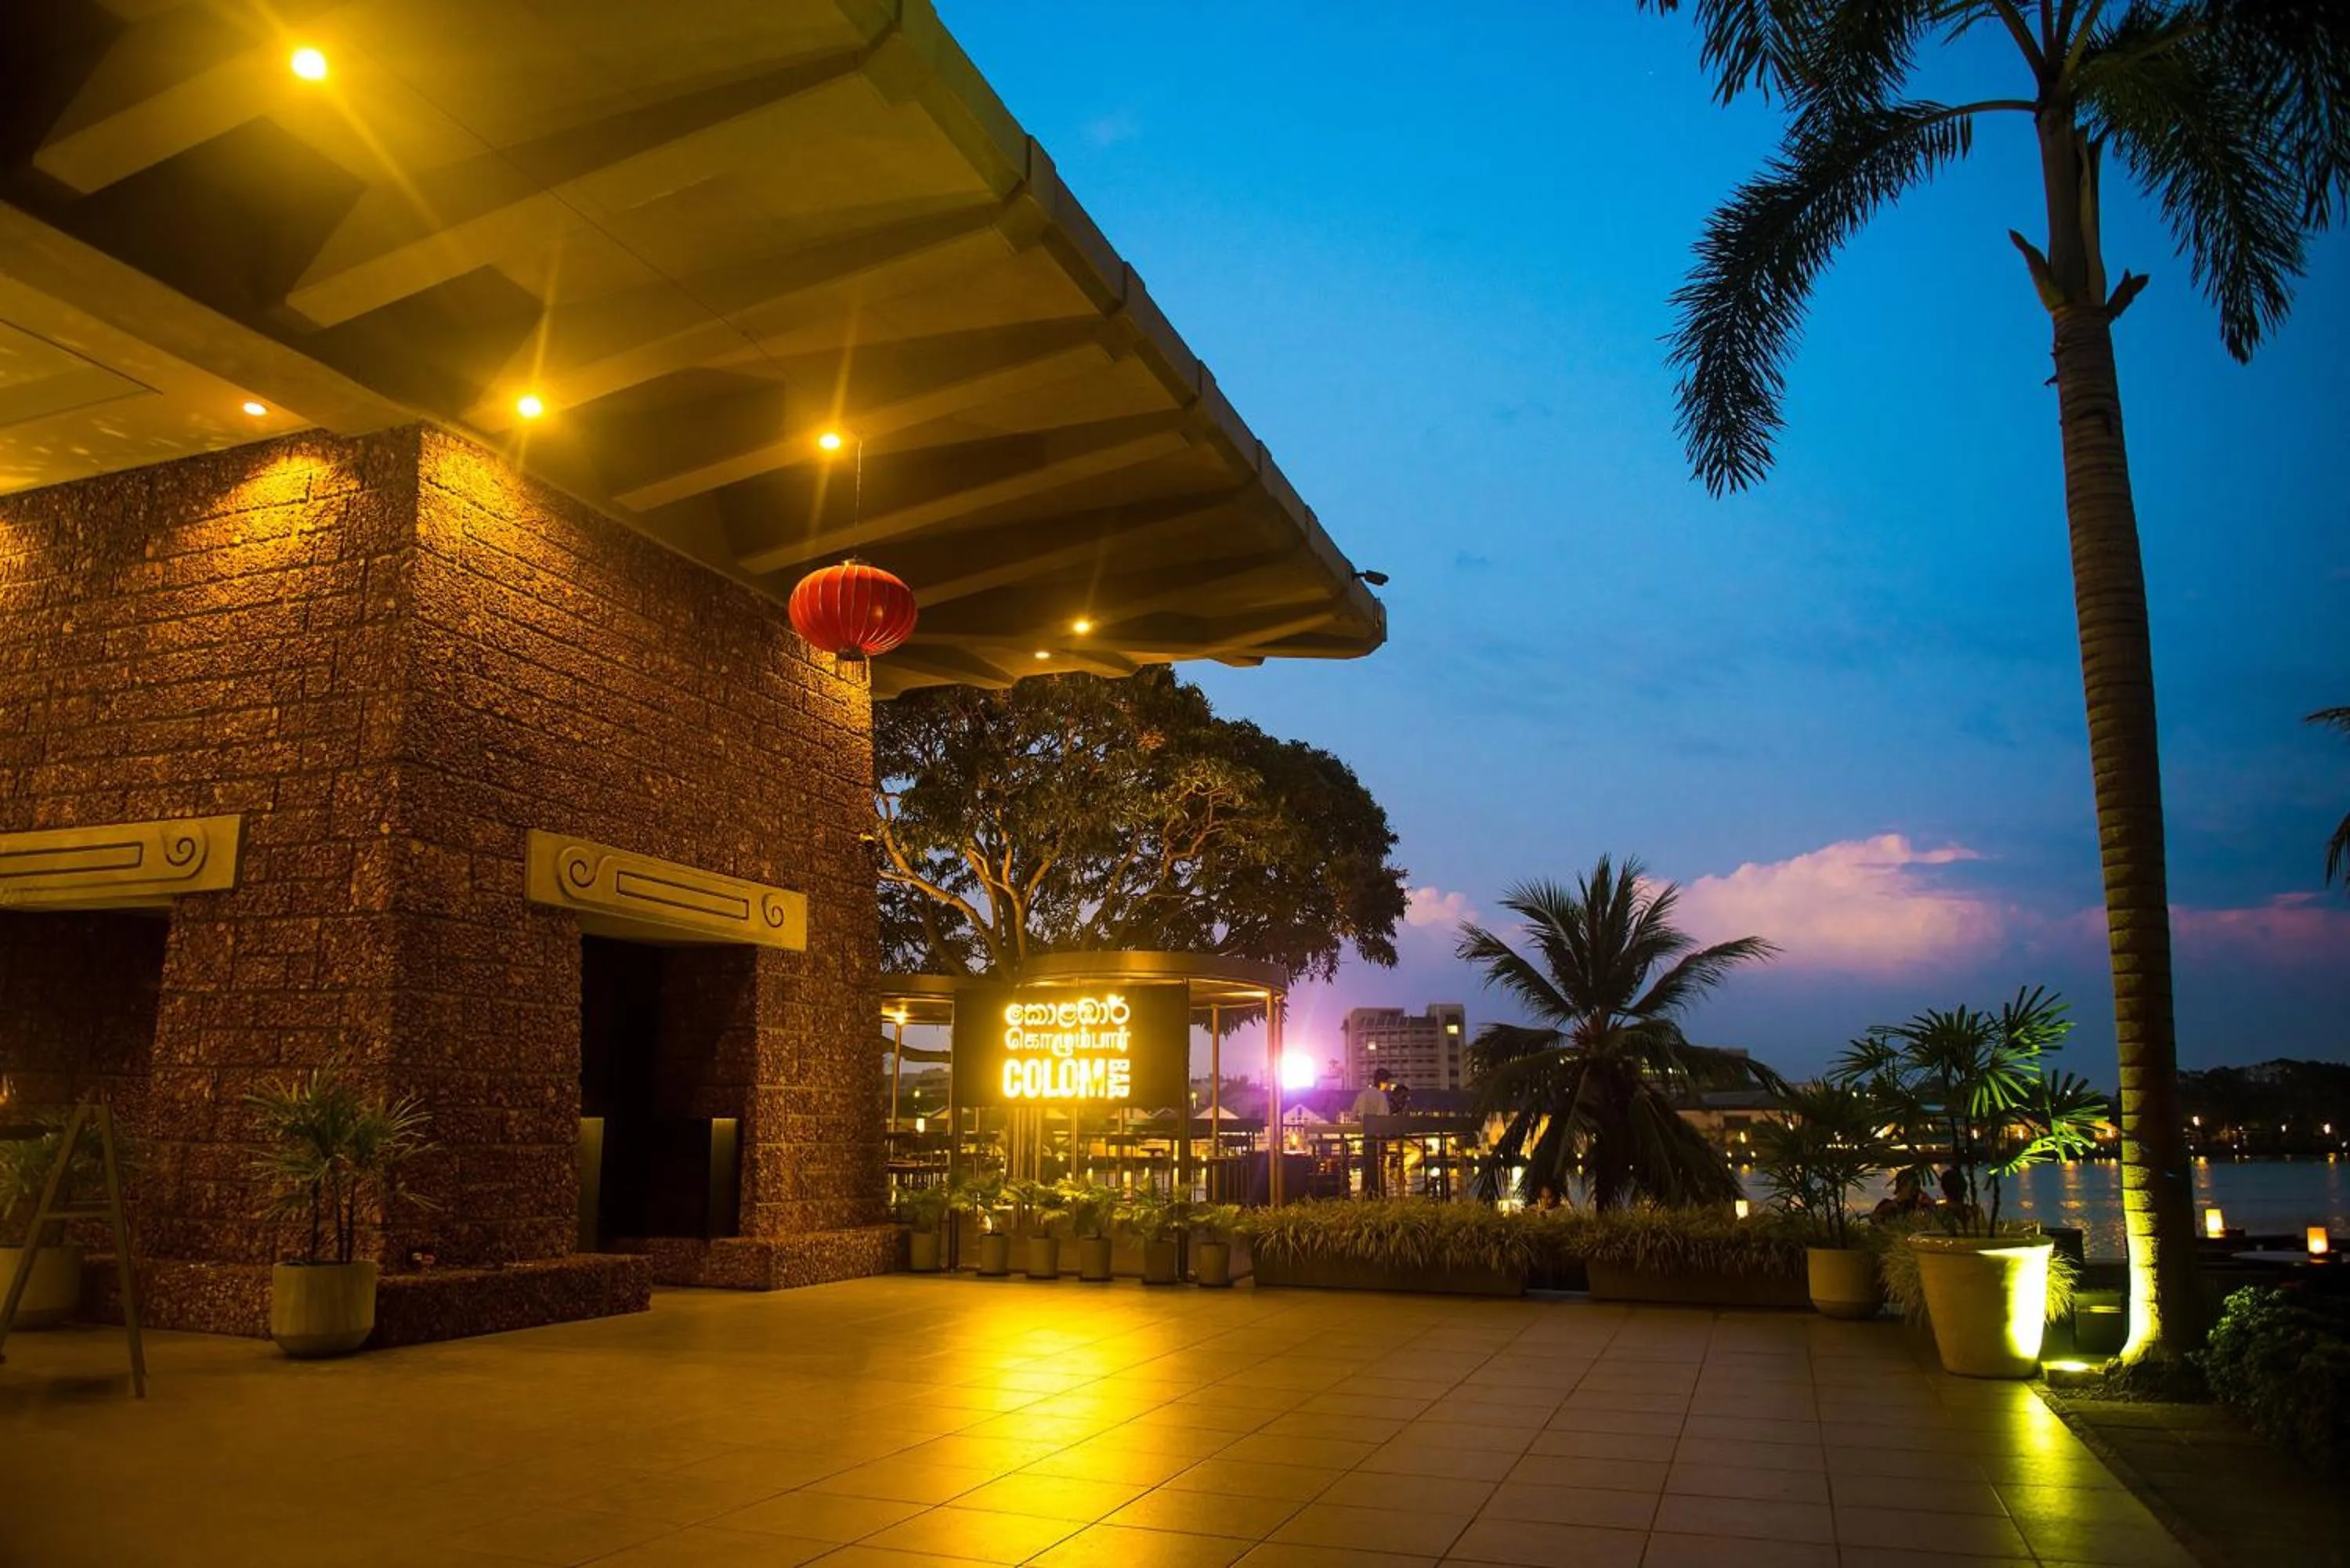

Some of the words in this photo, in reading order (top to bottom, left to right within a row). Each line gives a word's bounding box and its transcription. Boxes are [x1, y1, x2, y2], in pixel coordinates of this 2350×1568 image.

[1005, 1026, 1130, 1057] கொழும்பார்
[1003, 1058, 1104, 1098] COLOM
[1108, 1059, 1130, 1099] BAR
